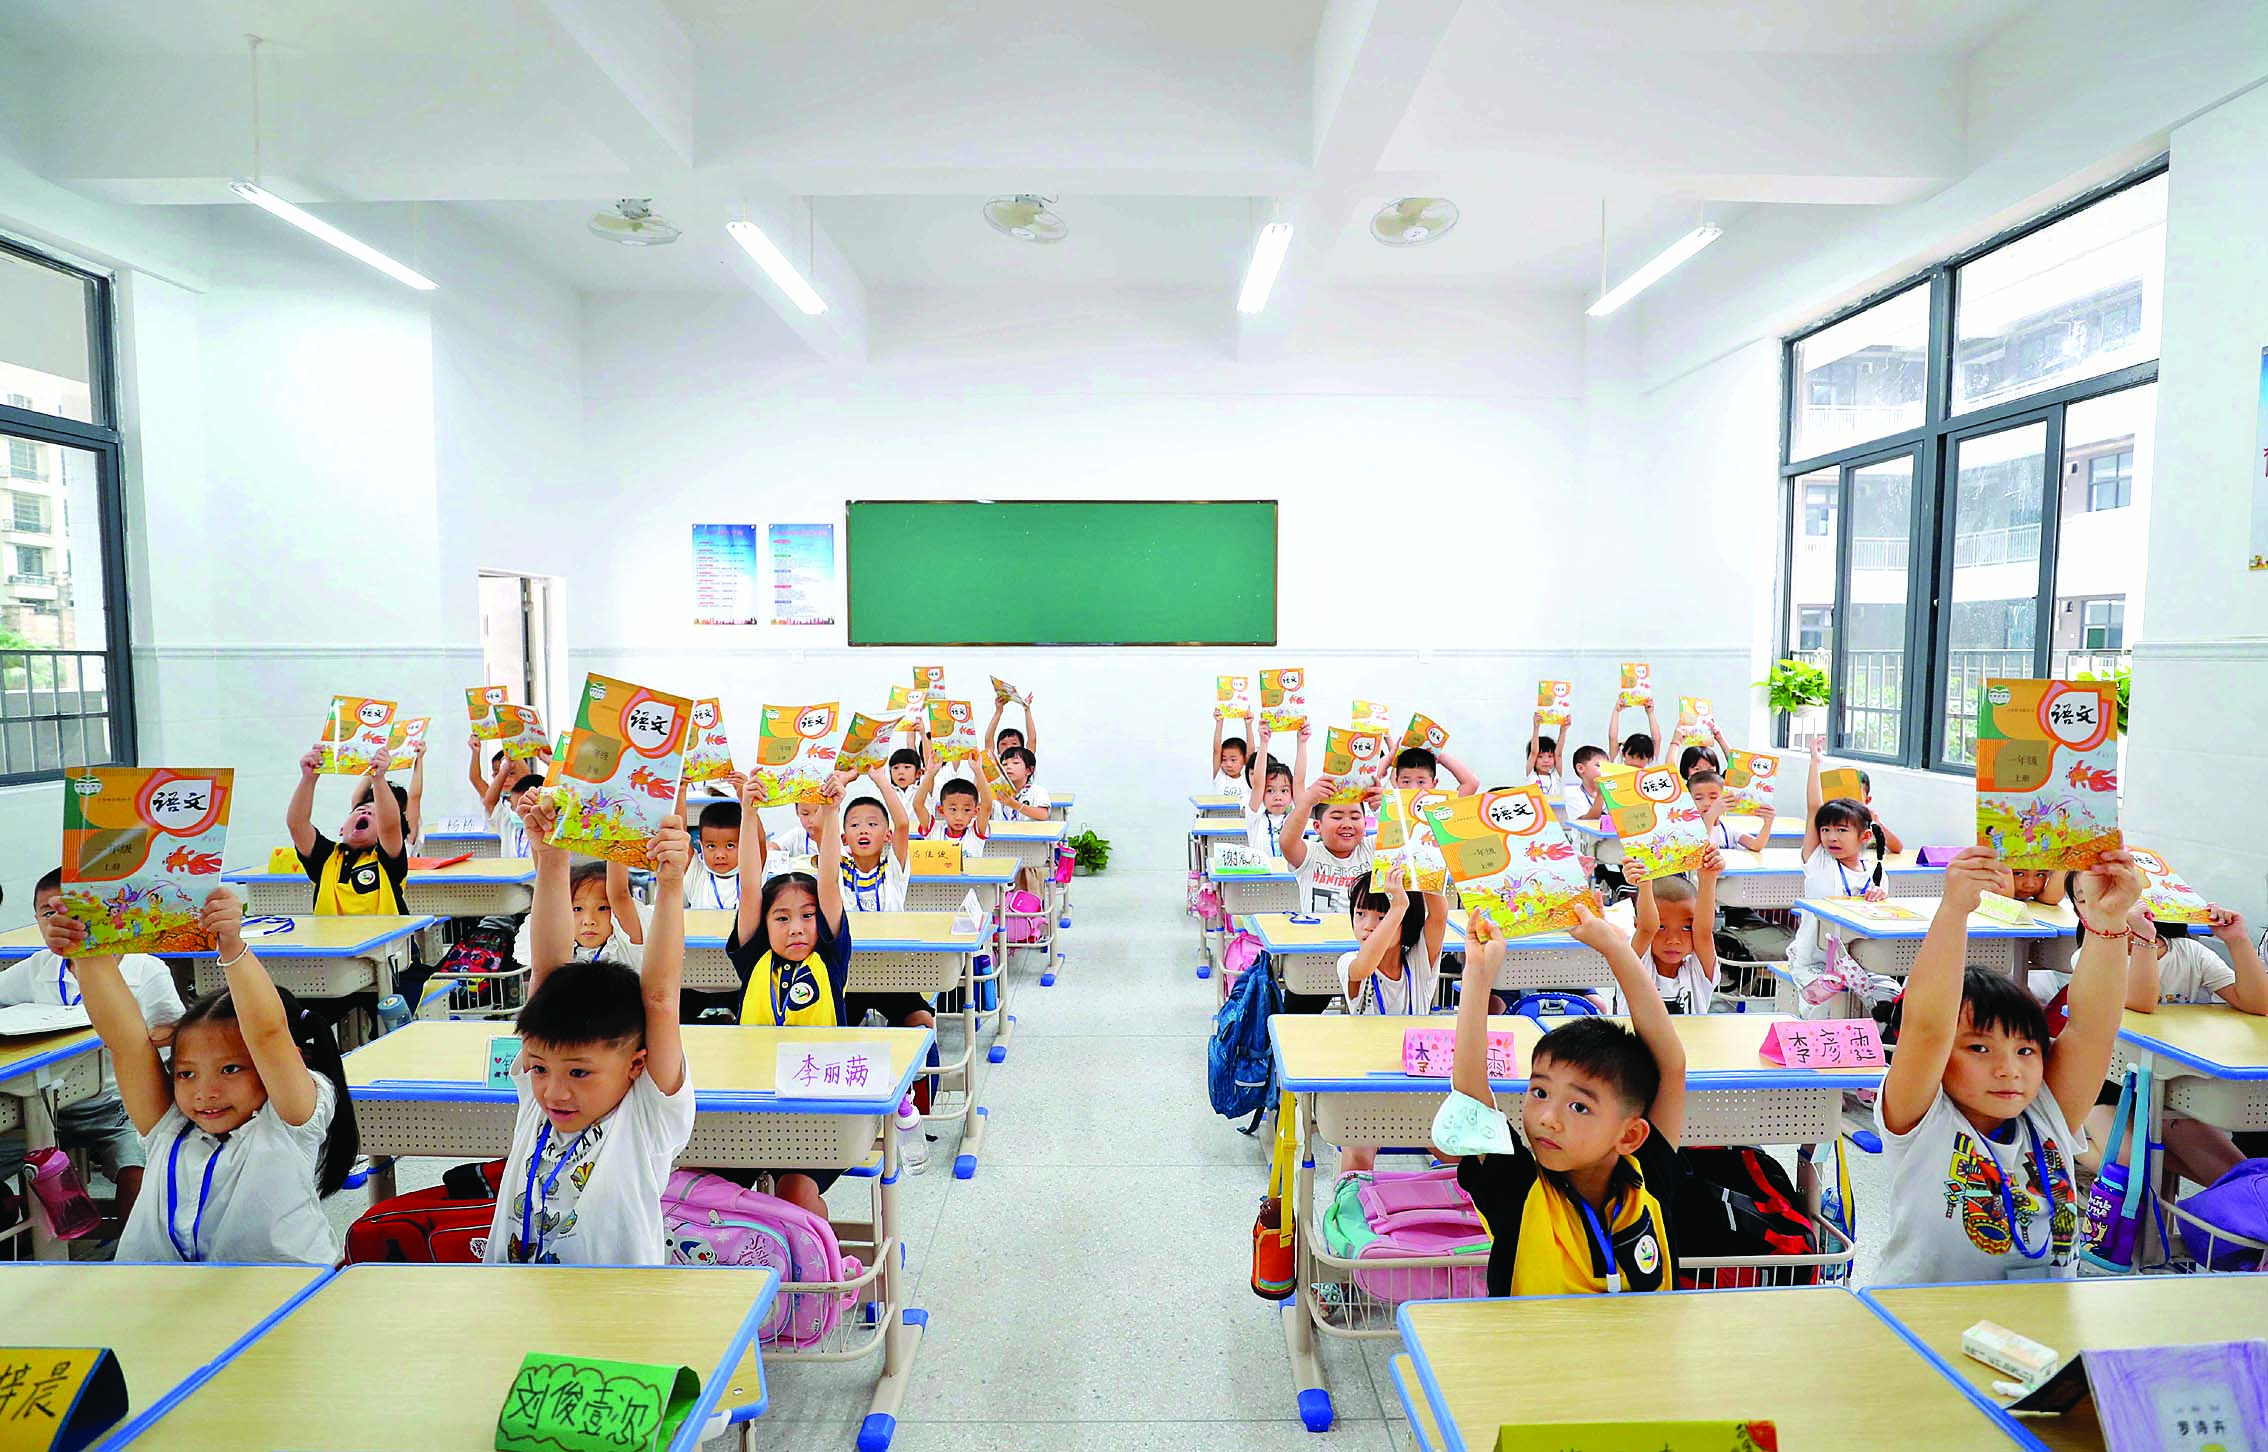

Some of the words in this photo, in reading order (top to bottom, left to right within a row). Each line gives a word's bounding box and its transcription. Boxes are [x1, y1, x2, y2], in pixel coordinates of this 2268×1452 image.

[631, 709, 668, 735] 语文
[801, 715, 826, 729] 语文
[2051, 703, 2097, 725] 语文
[2008, 754, 2039, 767] 一年级
[1643, 777, 1673, 793] 语文
[152, 791, 208, 813] 语文
[1491, 803, 1534, 822] 语文
[1414, 1040, 1506, 1078] 李霖
[792, 1053, 869, 1088] 李丽满
